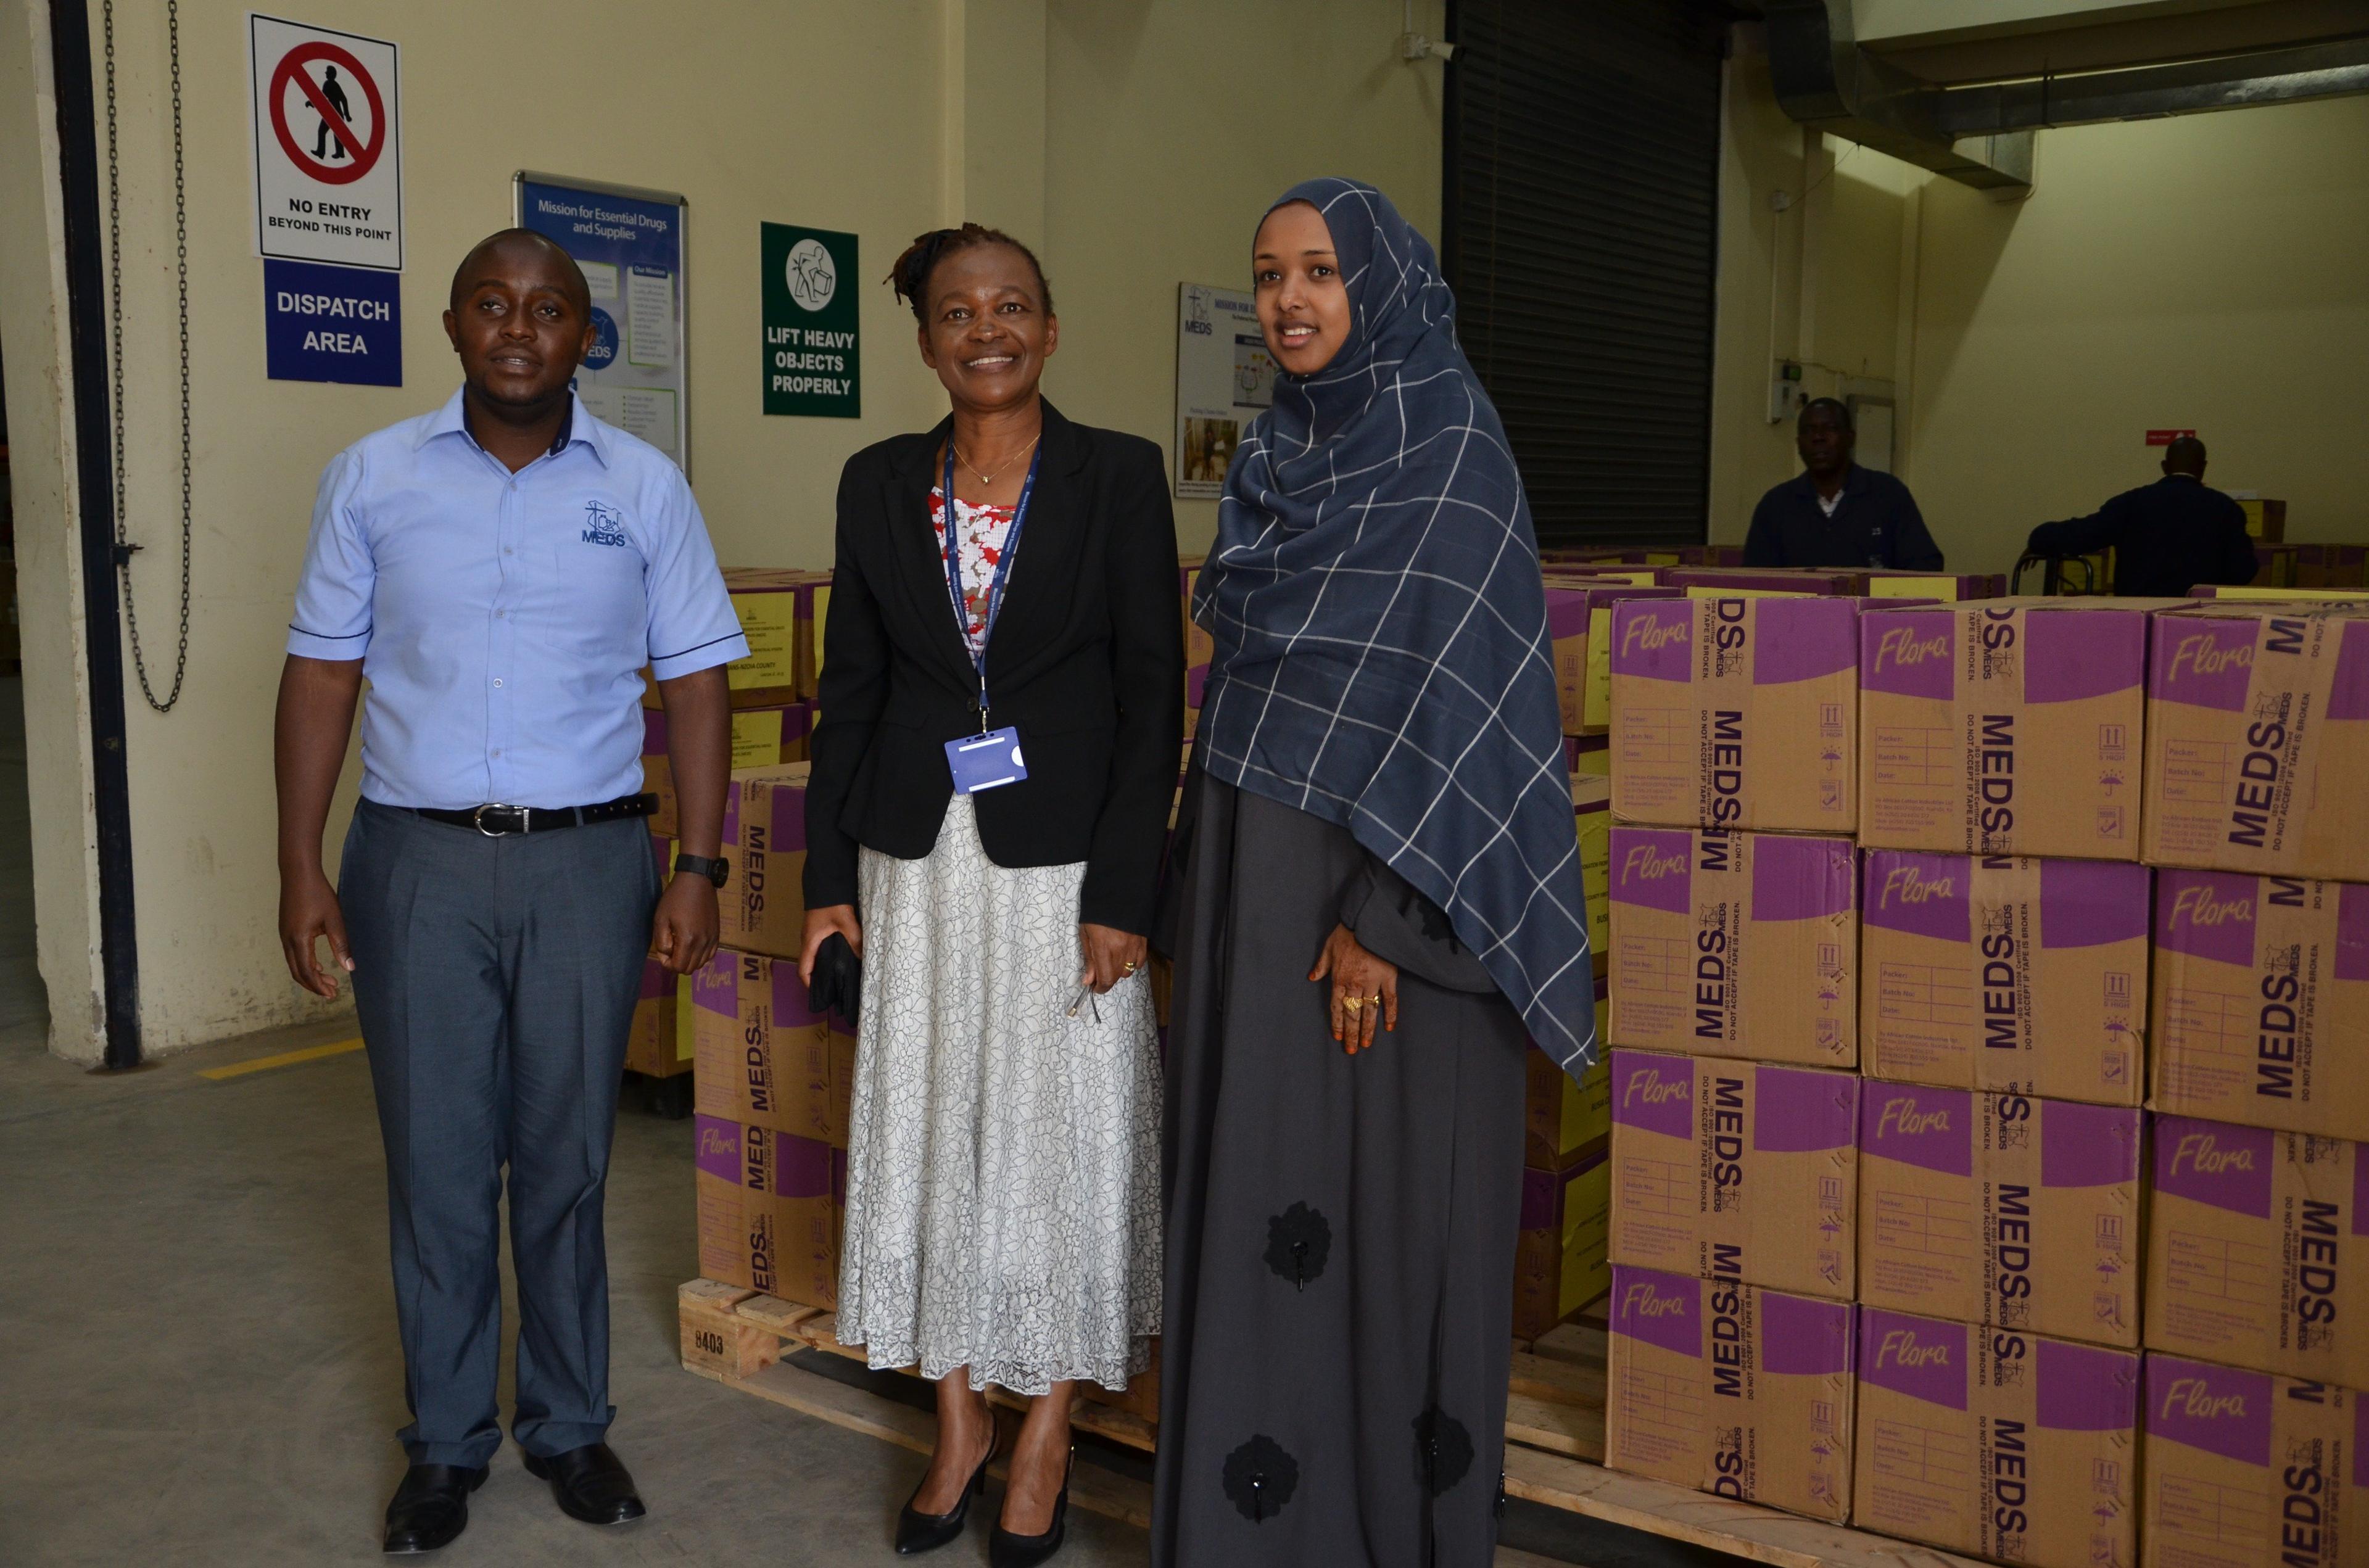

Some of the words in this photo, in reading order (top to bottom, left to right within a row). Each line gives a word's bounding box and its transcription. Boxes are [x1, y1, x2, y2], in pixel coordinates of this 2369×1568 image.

[289, 199, 312, 213] NO
[318, 202, 371, 221] ENTRY
[539, 199, 577, 215] Mission
[579, 205, 593, 218] for
[595, 208, 637, 225] Essential
[639, 215, 667, 231] Drugs
[269, 217, 319, 232] BEYOND
[323, 223, 351, 236] THIS
[356, 228, 391, 241] POINT
[573, 223, 593, 234] and
[595, 223, 635, 241] Supplies
[647, 266, 666, 275] Mission
[278, 292, 389, 321] DISPATCH
[303, 331, 368, 354] AREA
[768, 326, 800, 345] LIFT
[804, 329, 854, 349] HEAVY
[1185, 320, 1212, 336] MEDS
[588, 347, 611, 358] EDS
[775, 352, 844, 371] OBJECTS
[773, 375, 851, 395] PROPERLY
[582, 530, 625, 547] MEDS
[1622, 613, 1688, 658] Flora
[1716, 599, 1746, 649] DS
[1716, 648, 1724, 677] MEDS
[1875, 627, 1949, 674] Flora
[1983, 649, 1992, 679] MEDS
[2169, 632, 2252, 682] Flora
[1701, 710, 1708, 720] DO
[1967, 714, 1974, 725] DO
[2276, 691, 2293, 725] MEDS
[2296, 691, 2310, 731] BROKEN.
[2294, 734, 2302, 742] IS
[1713, 711, 1742, 822] MEDS
[2288, 744, 2300, 767] TAPE
[1700, 774, 1708, 782] IF
[1980, 715, 2014, 832] MEDS
[2228, 722, 2286, 848] MEDS
[2286, 769, 2294, 778] IF
[2279, 780, 2293, 815] ACCEPT
[2275, 817, 2285, 836] NOT
[2273, 838, 2282, 851] DO
[748, 826, 765, 912] MEDS
[1621, 844, 1687, 886] Flora
[1880, 865, 1953, 910] Flora
[1718, 902, 1727, 931] MEDS
[2003, 904, 2012, 935] MEDS
[2020, 902, 2028, 938] BROKEN.
[2167, 885, 2252, 933] Flora
[2022, 941, 2028, 949] IS
[2289, 944, 2301, 976] MEDS
[696, 960, 731, 992] Flora
[1695, 929, 1726, 1039] MEDS
[1883, 970, 1908, 979] Packer:
[1982, 933, 2017, 1049] MEDS
[1730, 1029, 1736, 1041] DO
[2025, 1038, 2032, 1050] DO
[2257, 975, 2299, 1098] MEDS
[745, 1026, 769, 1112] MEDS
[1703, 1076, 1709, 1087] DO
[1624, 1068, 1689, 1109] Flora
[1714, 1078, 1743, 1187] MEDS
[1876, 1096, 1951, 1139] Flora
[700, 1127, 737, 1157] Flora
[1998, 1120, 2007, 1150] MEDS
[748, 1126, 764, 1190] MED
[2170, 1133, 2255, 1178] Flora
[1714, 1184, 1722, 1213] MEDS
[1998, 1184, 2031, 1299] MEDS
[750, 1232, 770, 1291] EDS
[2298, 1199, 2338, 1324] MEDS
[1622, 1282, 1685, 1318] Flora
[1999, 1296, 2007, 1325] MEDS
[1711, 1291, 1741, 1398] MEDS
[1875, 1330, 1949, 1369] Flora
[2297, 1319, 2307, 1350] MEDS
[1993, 1356, 2003, 1387] MEDS
[2162, 1378, 2246, 1419] Flora
[1734, 1427, 1742, 1455] MEDS
[2312, 1437, 2323, 1469] MEDS
[1714, 1451, 1743, 1500] DS
[1994, 1419, 2027, 1533] MEDS
[1995, 1530, 2005, 1559] MEDS
